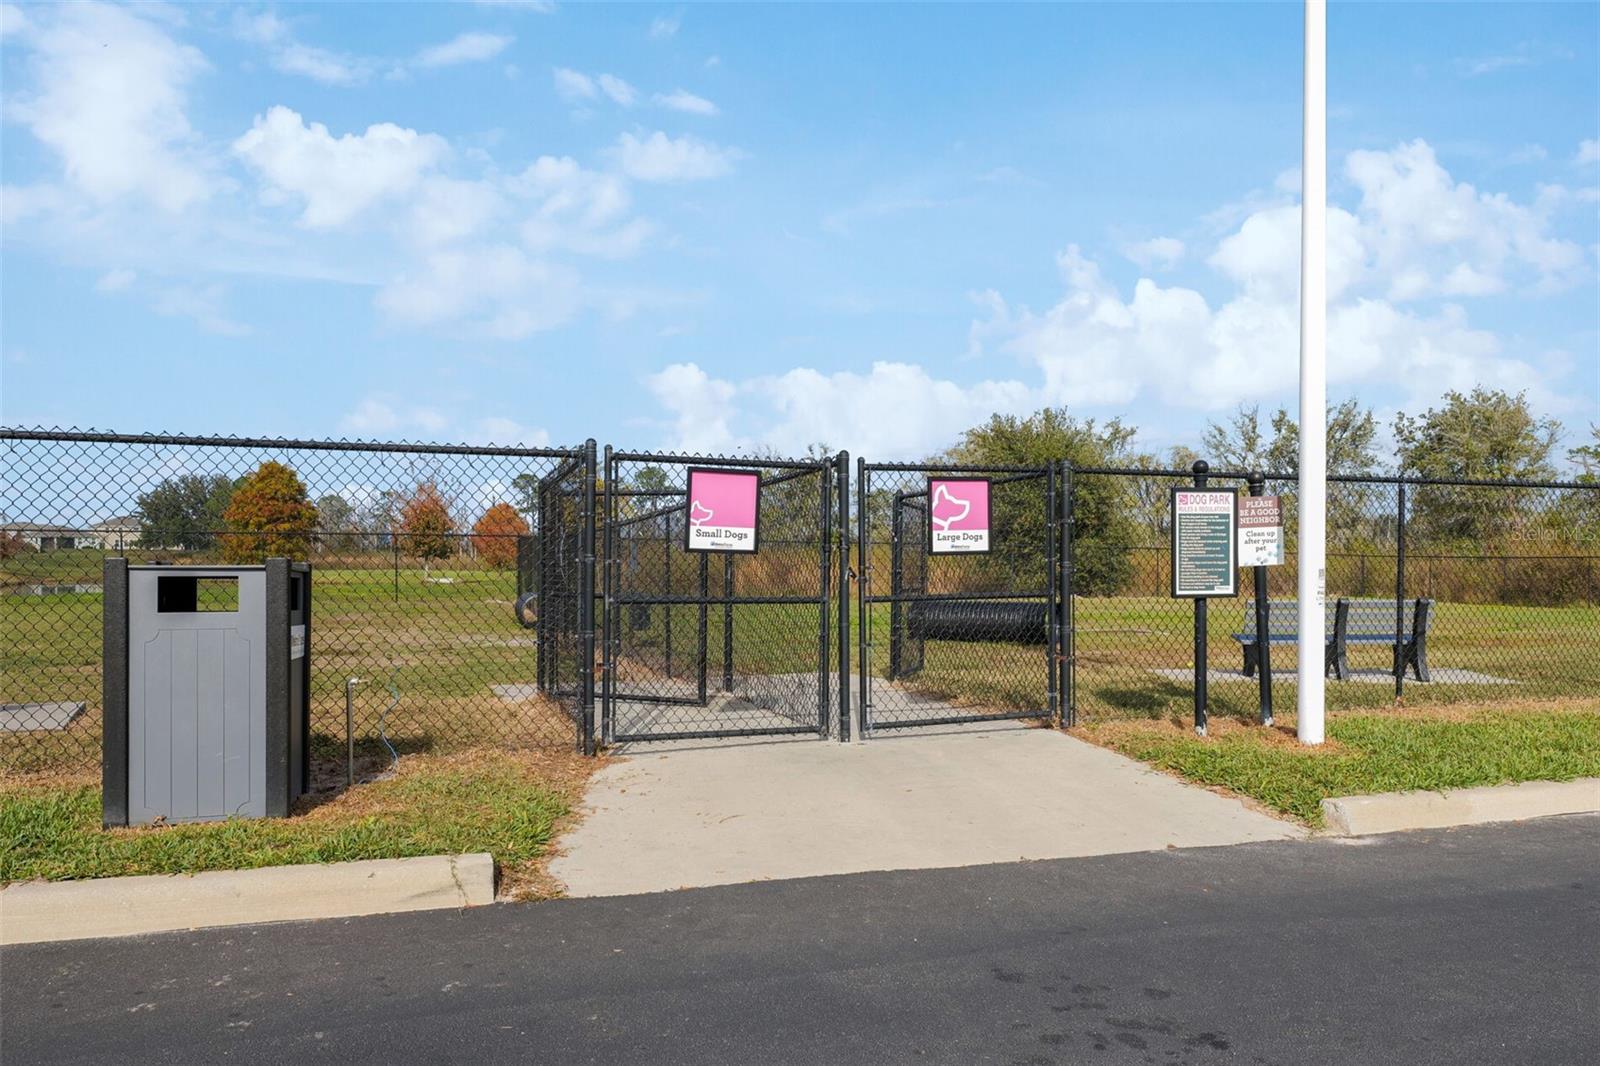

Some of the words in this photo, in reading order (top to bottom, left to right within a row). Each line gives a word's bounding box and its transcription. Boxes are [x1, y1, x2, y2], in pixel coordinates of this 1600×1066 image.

[1190, 494, 1207, 504] DOG
[1209, 494, 1230, 504] PARK
[1246, 500, 1272, 508] PLEASE
[696, 528, 722, 538] Small
[724, 530, 748, 540] Dogs
[937, 533, 960, 542] Large
[962, 532, 983, 542] Dogs
